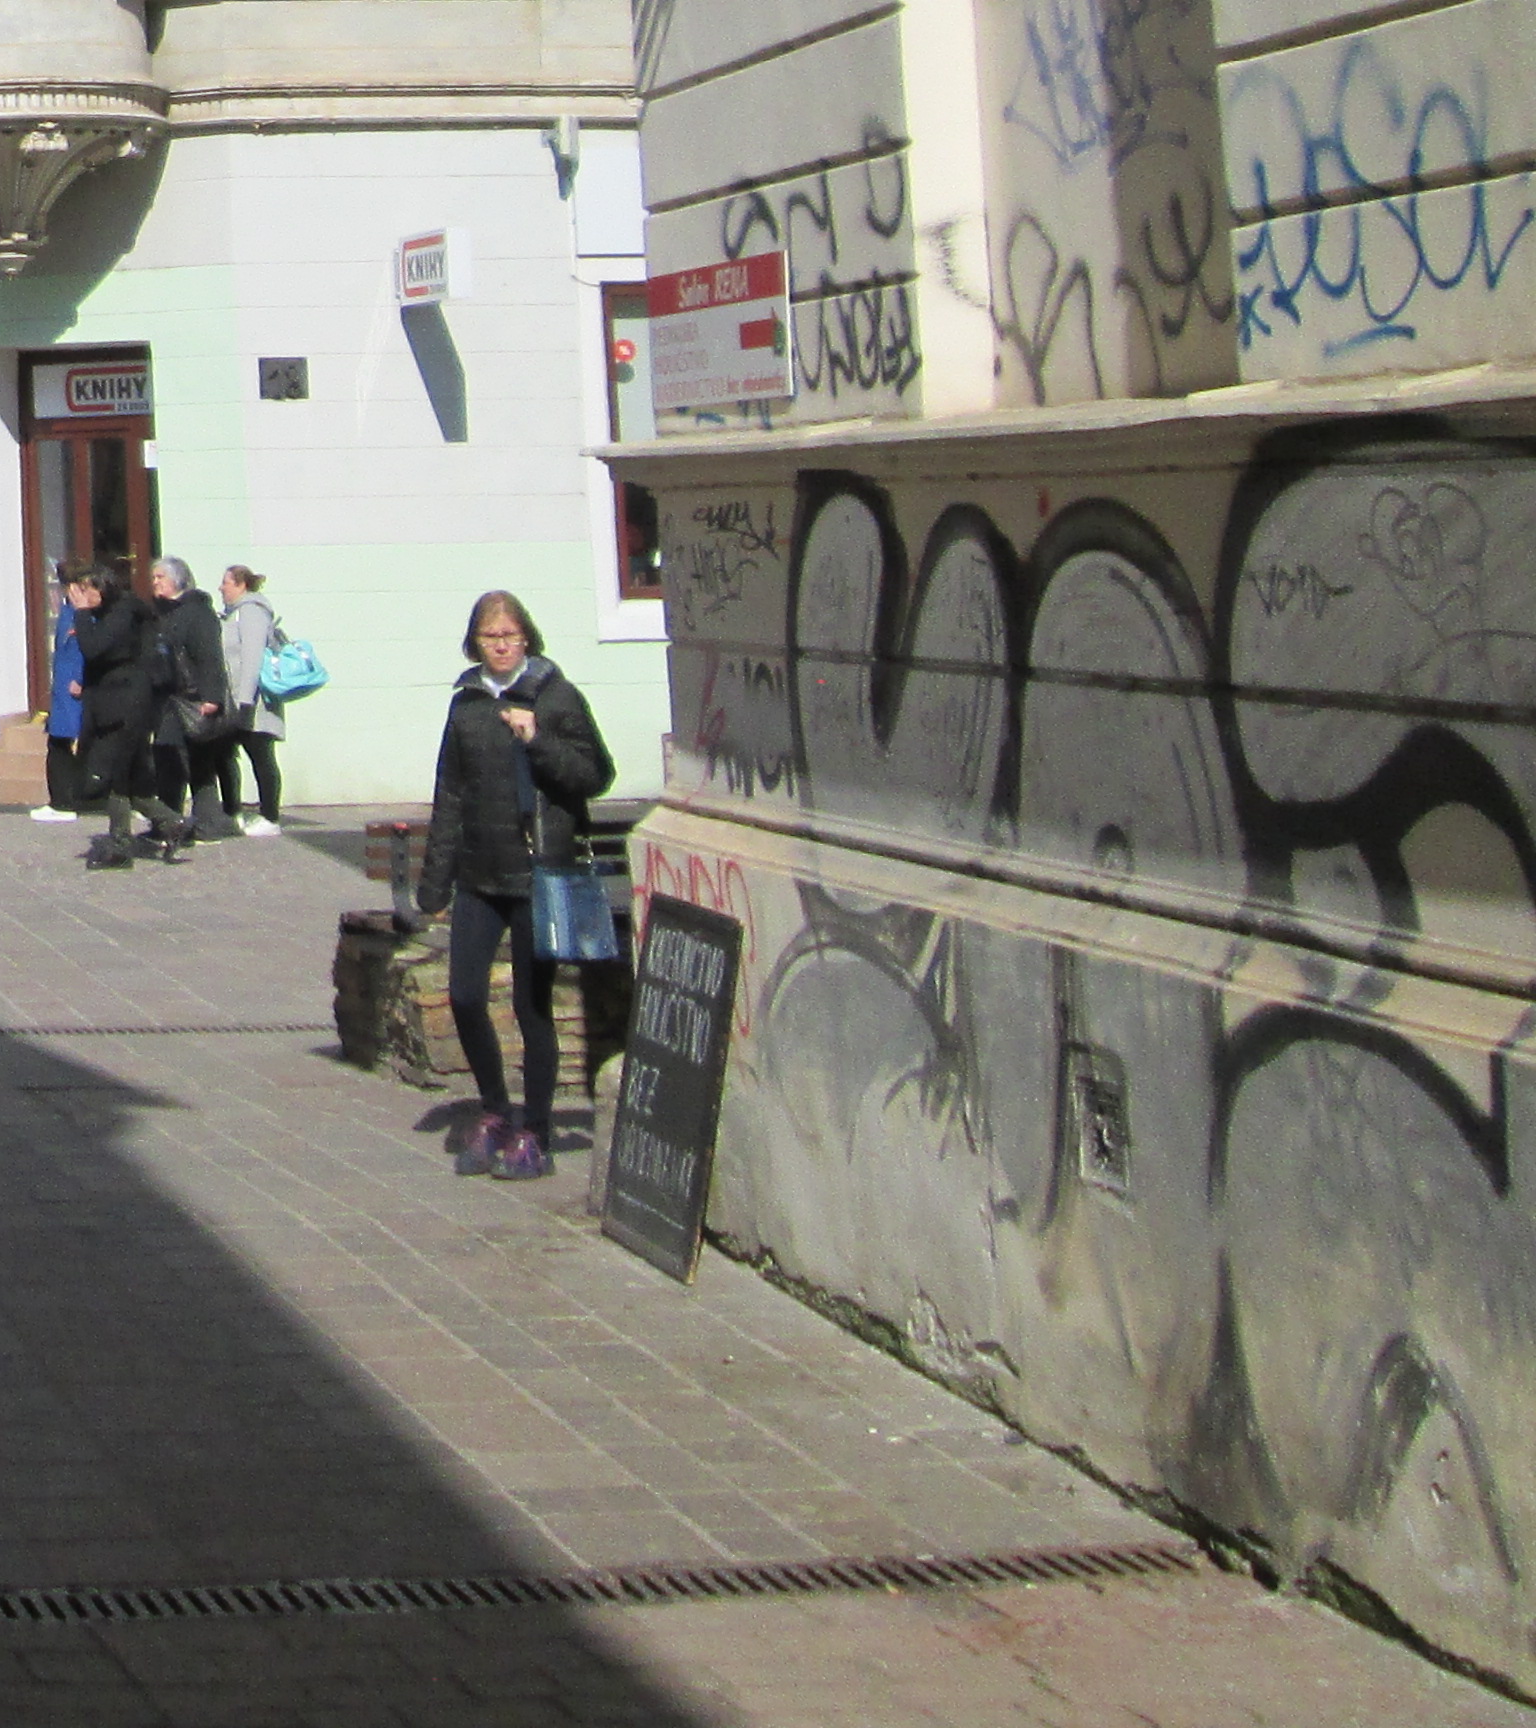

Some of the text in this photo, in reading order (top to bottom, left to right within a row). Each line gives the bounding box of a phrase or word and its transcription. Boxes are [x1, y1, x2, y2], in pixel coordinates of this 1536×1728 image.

[408, 251, 444, 282] KNIHY
[75, 376, 147, 400] KNIHY
[627, 1058, 660, 1116] BEZ
